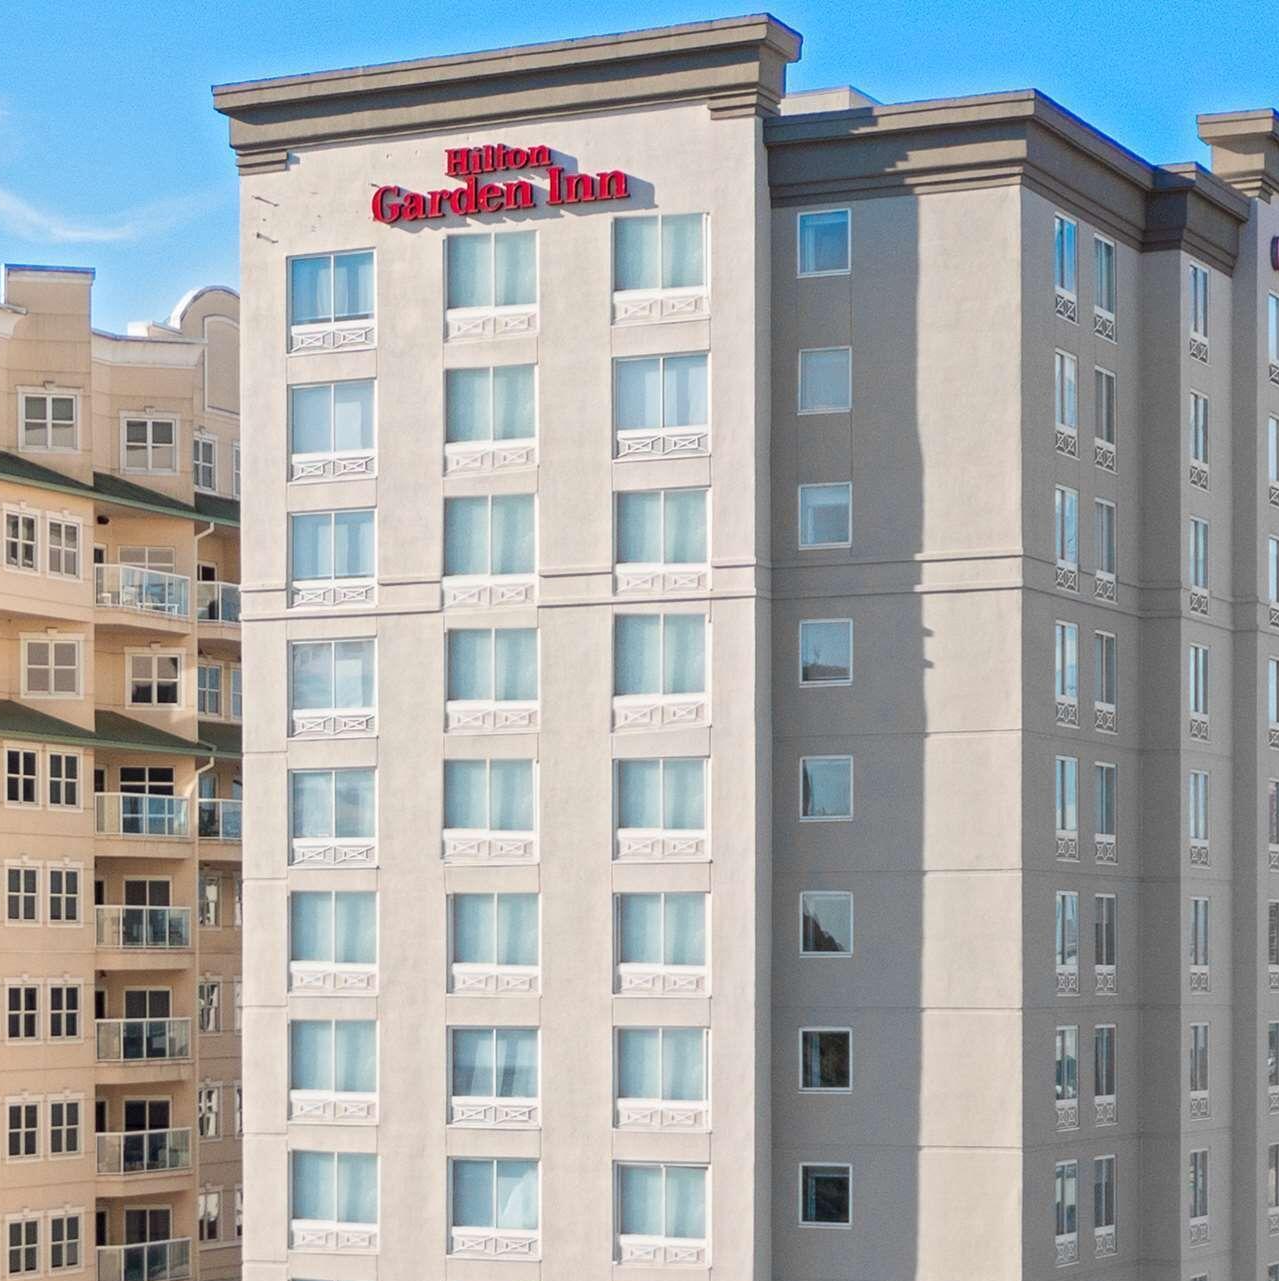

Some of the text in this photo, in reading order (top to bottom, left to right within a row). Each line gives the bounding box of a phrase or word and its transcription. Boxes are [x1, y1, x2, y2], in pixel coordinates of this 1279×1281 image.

[445, 144, 553, 177] Hilton
[371, 166, 631, 225] Garden Inn
